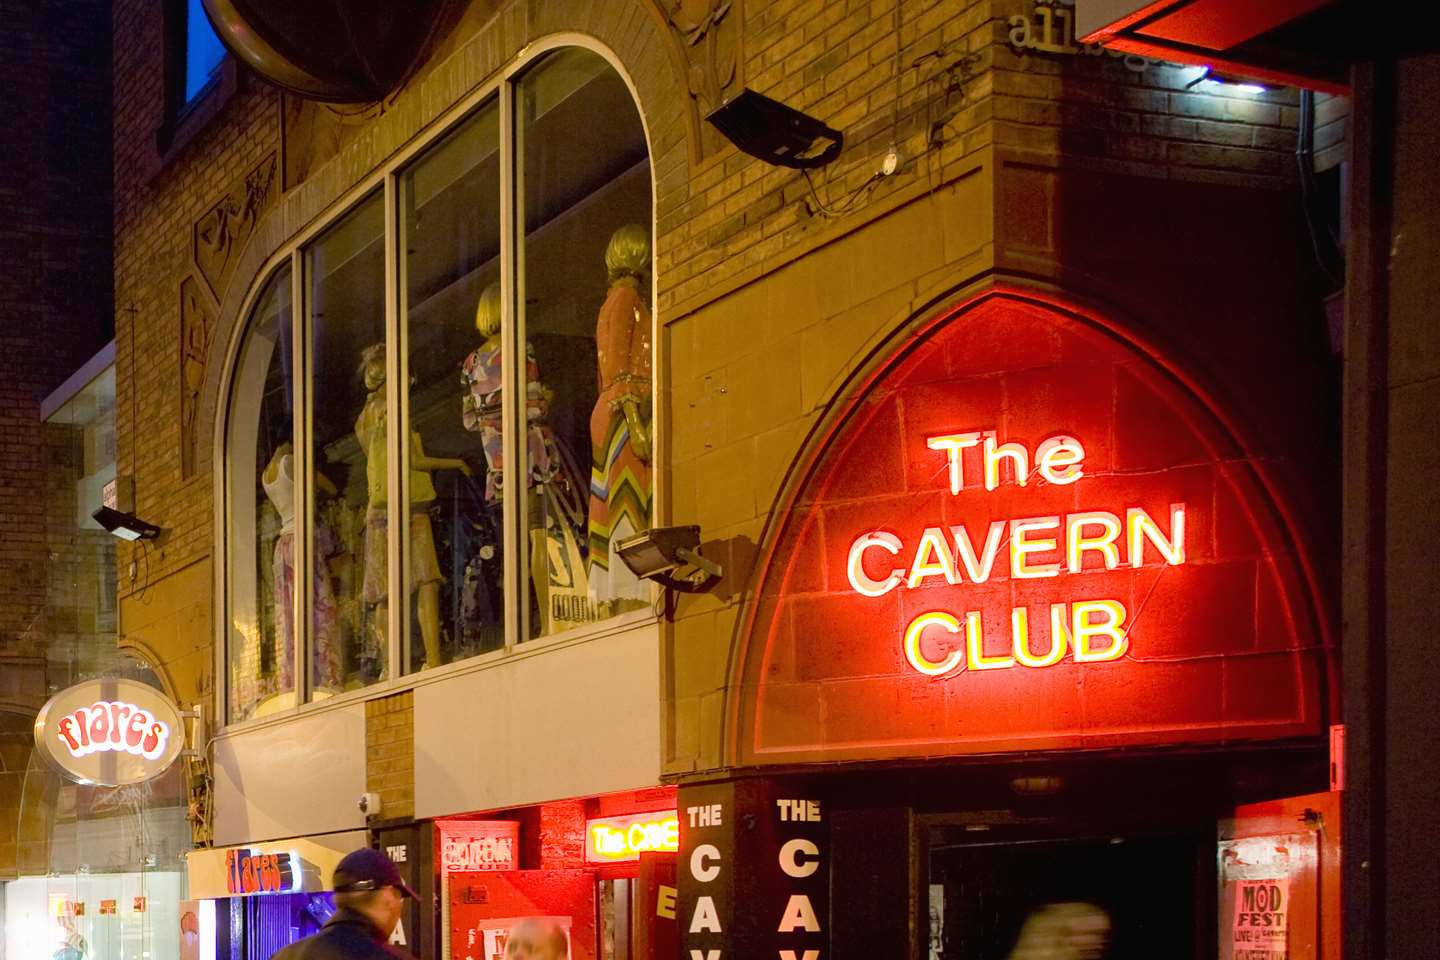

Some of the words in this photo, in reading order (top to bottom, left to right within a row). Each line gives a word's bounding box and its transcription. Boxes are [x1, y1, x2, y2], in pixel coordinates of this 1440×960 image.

[927, 430, 1085, 496] The
[846, 503, 1186, 597] CAVERN
[904, 599, 1128, 677] CLUB
[57, 702, 164, 754] flares
[687, 804, 722, 828] THE
[777, 799, 821, 823] THE
[387, 845, 406, 862] THE
[592, 827, 625, 853] The
[224, 848, 281, 894] flares
[1242, 884, 1282, 912] MOD
[1237, 912, 1284, 927] FEST
